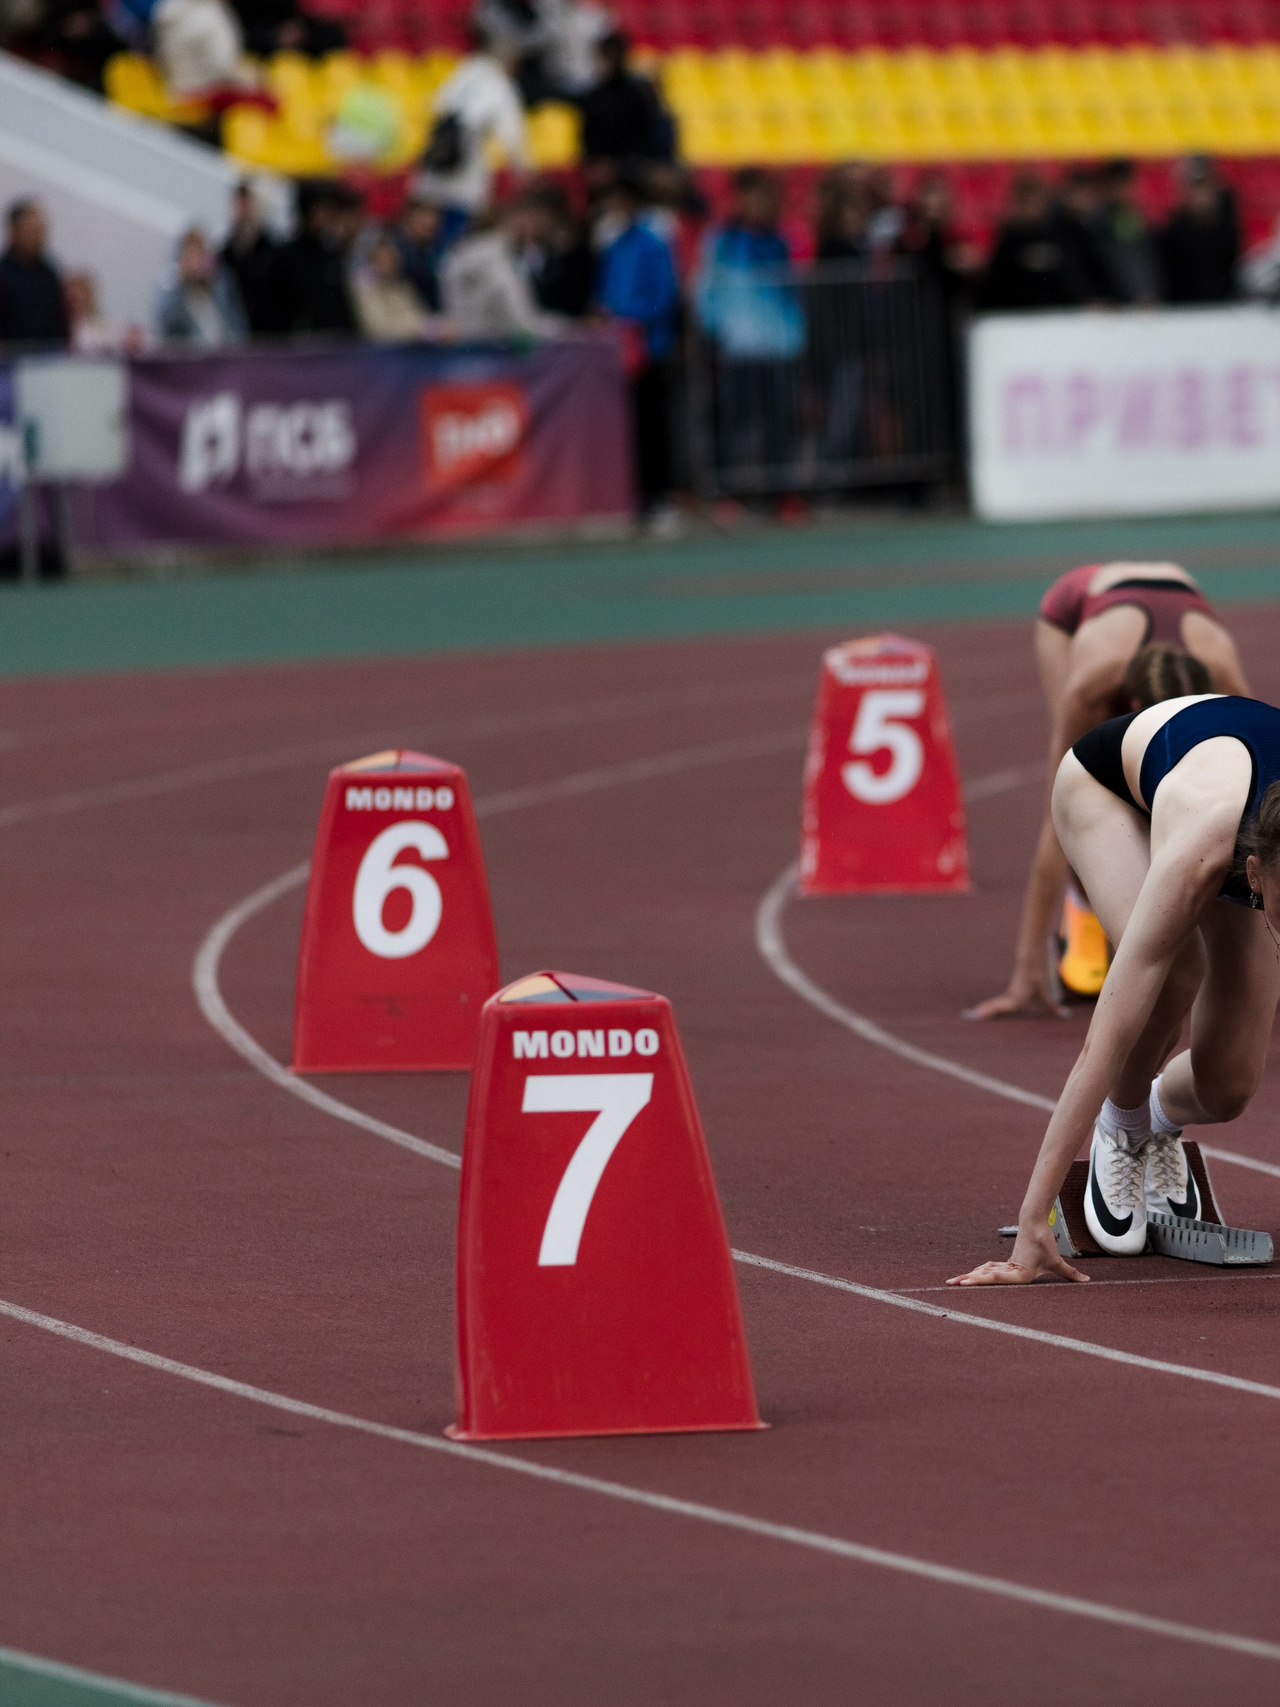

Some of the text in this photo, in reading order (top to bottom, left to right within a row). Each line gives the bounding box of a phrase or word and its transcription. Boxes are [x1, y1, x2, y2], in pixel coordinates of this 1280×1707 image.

[345, 786, 454, 811] MONDO
[840, 689, 926, 805] 5
[352, 820, 449, 958] 6
[512, 1028, 660, 1059] MONDO
[522, 1073, 654, 1266] 7
